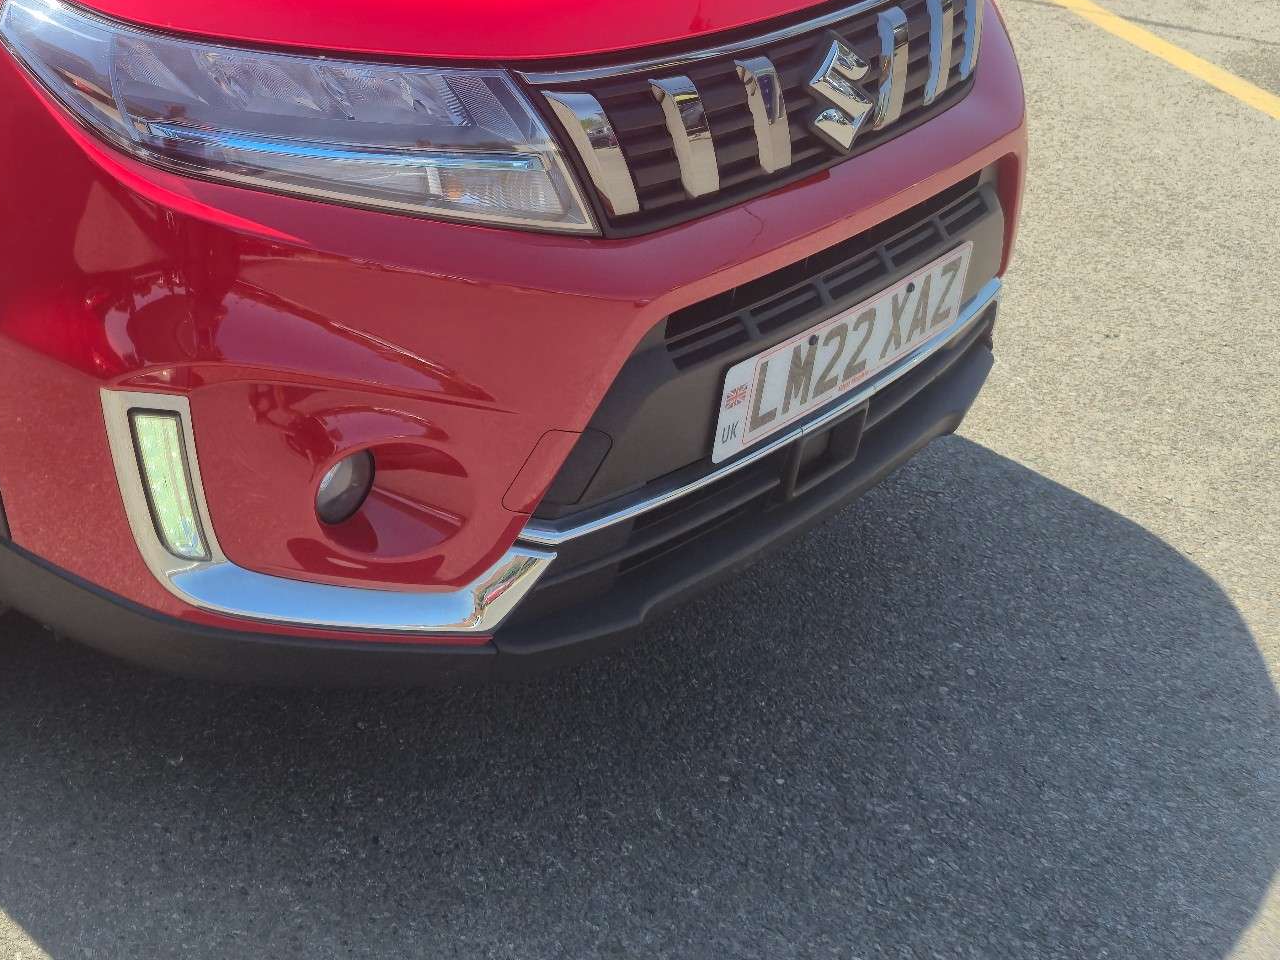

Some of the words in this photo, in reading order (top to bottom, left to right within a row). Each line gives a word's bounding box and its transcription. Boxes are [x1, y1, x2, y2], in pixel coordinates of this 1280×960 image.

[749, 308, 876, 431] LM22
[879, 256, 962, 361] XAZ
[721, 421, 739, 444] UK
